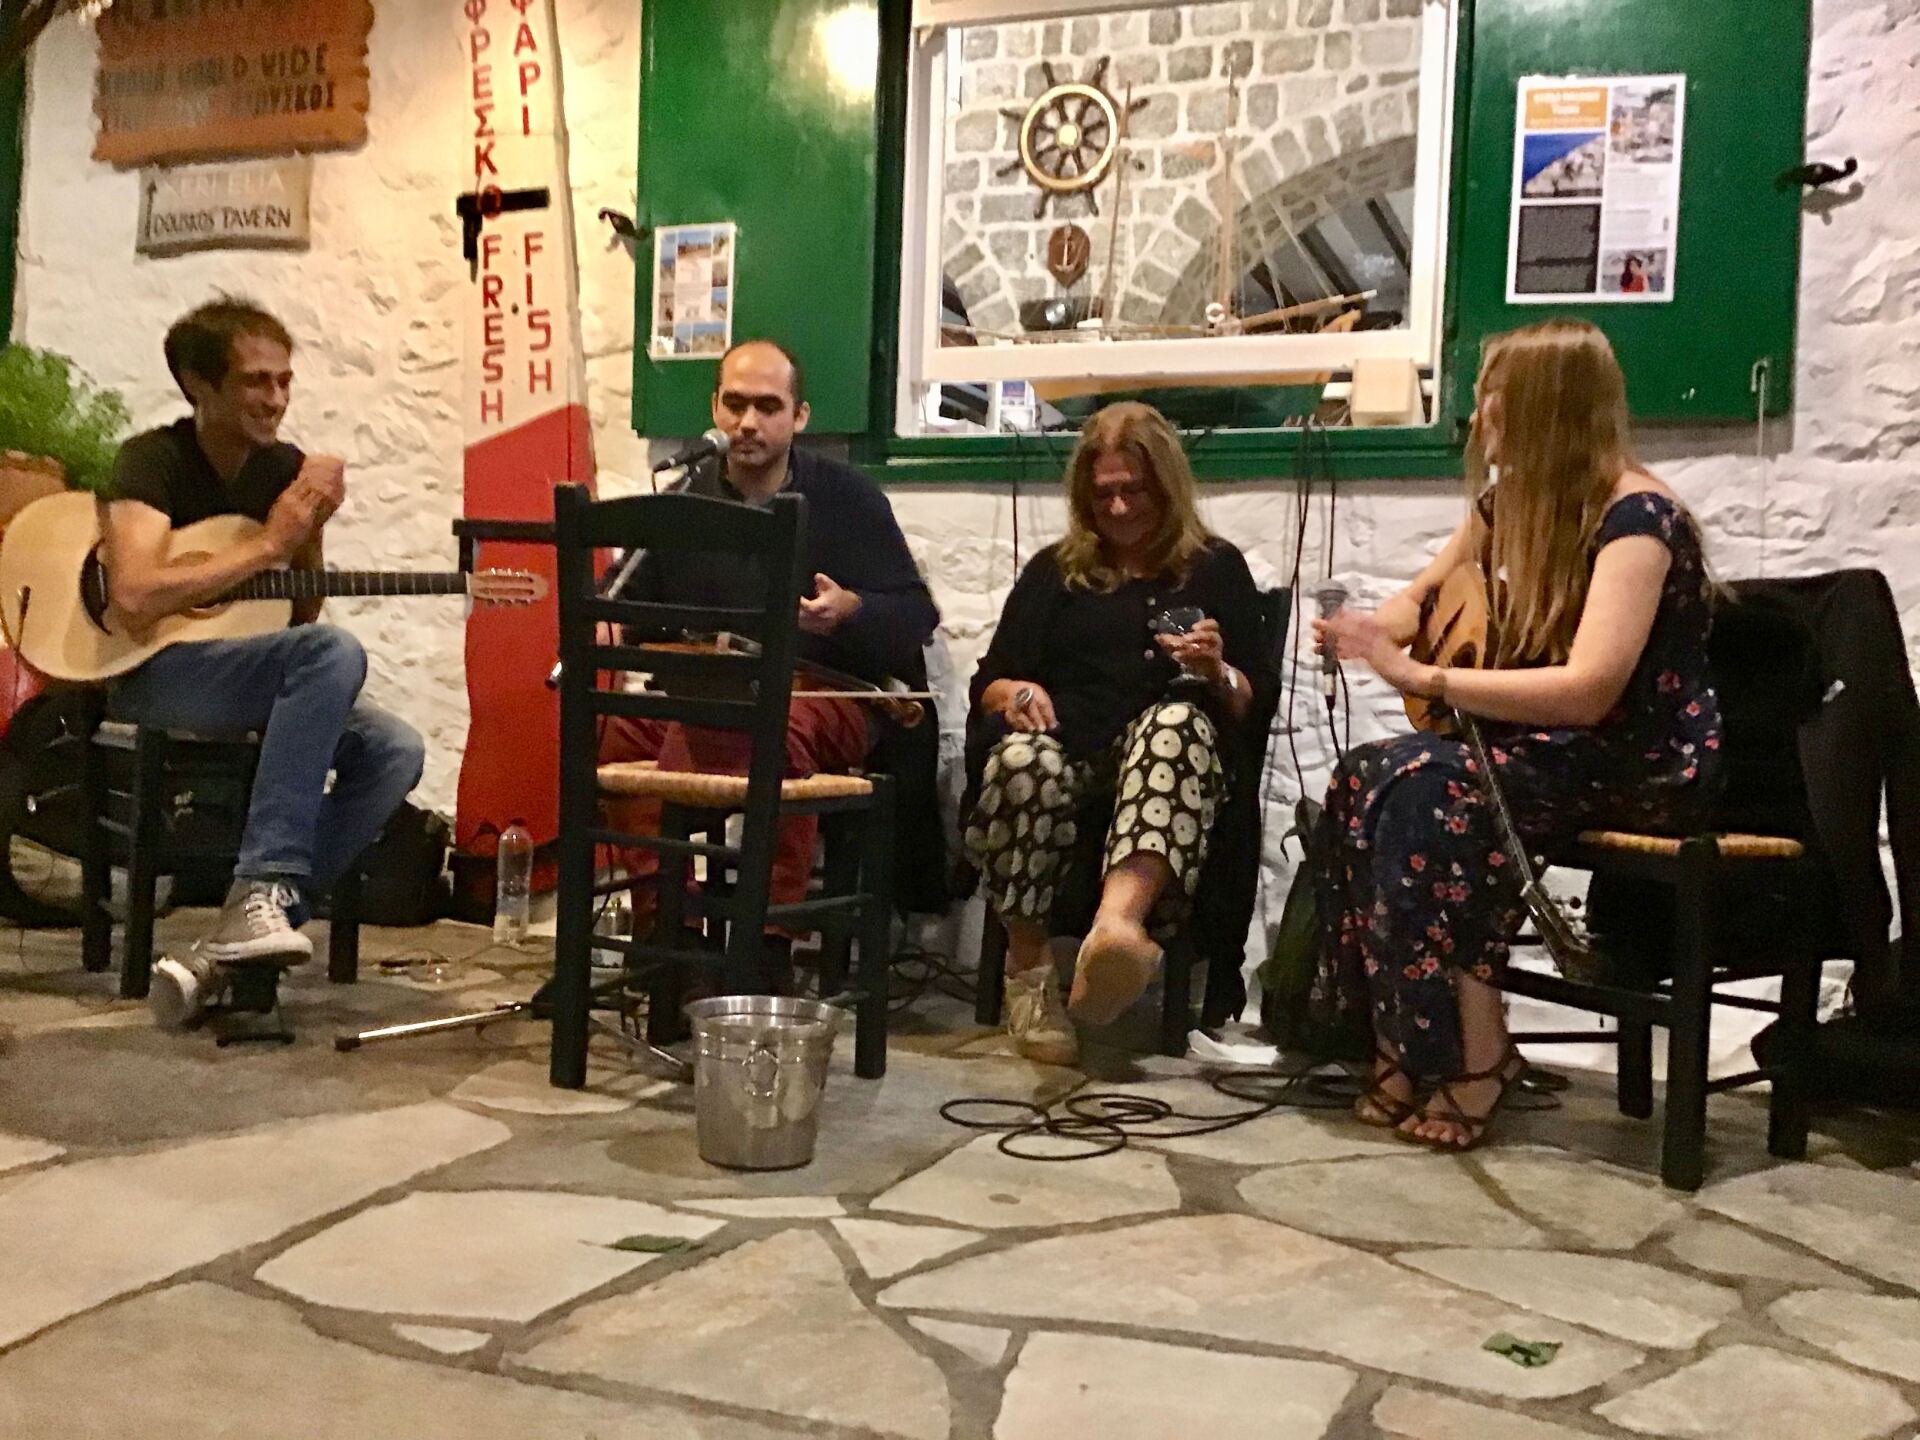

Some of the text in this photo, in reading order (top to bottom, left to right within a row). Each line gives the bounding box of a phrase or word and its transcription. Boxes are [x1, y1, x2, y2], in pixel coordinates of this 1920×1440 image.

[222, 204, 291, 230] TAVERN
[481, 235, 505, 424] FRESH
[524, 232, 552, 394] FISH
